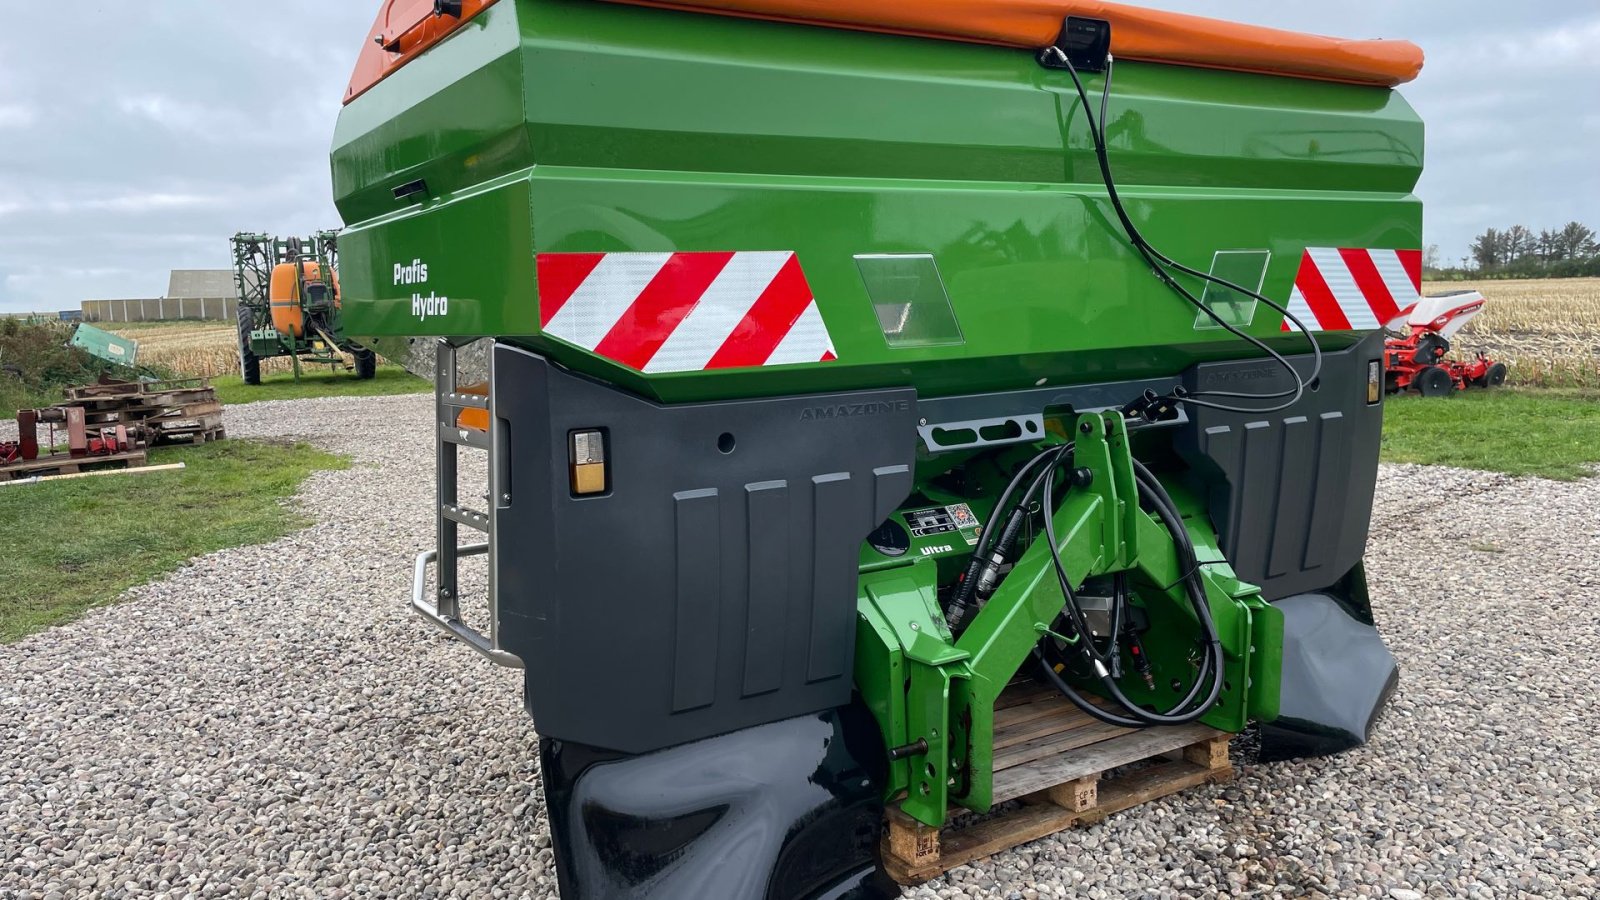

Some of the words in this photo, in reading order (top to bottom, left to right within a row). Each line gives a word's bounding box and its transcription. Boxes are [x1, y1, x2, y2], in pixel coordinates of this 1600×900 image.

[393, 258, 428, 286] Profis
[412, 290, 448, 322] Hydro
[800, 399, 909, 421] AMAZONE
[920, 544, 953, 556] Ultra
